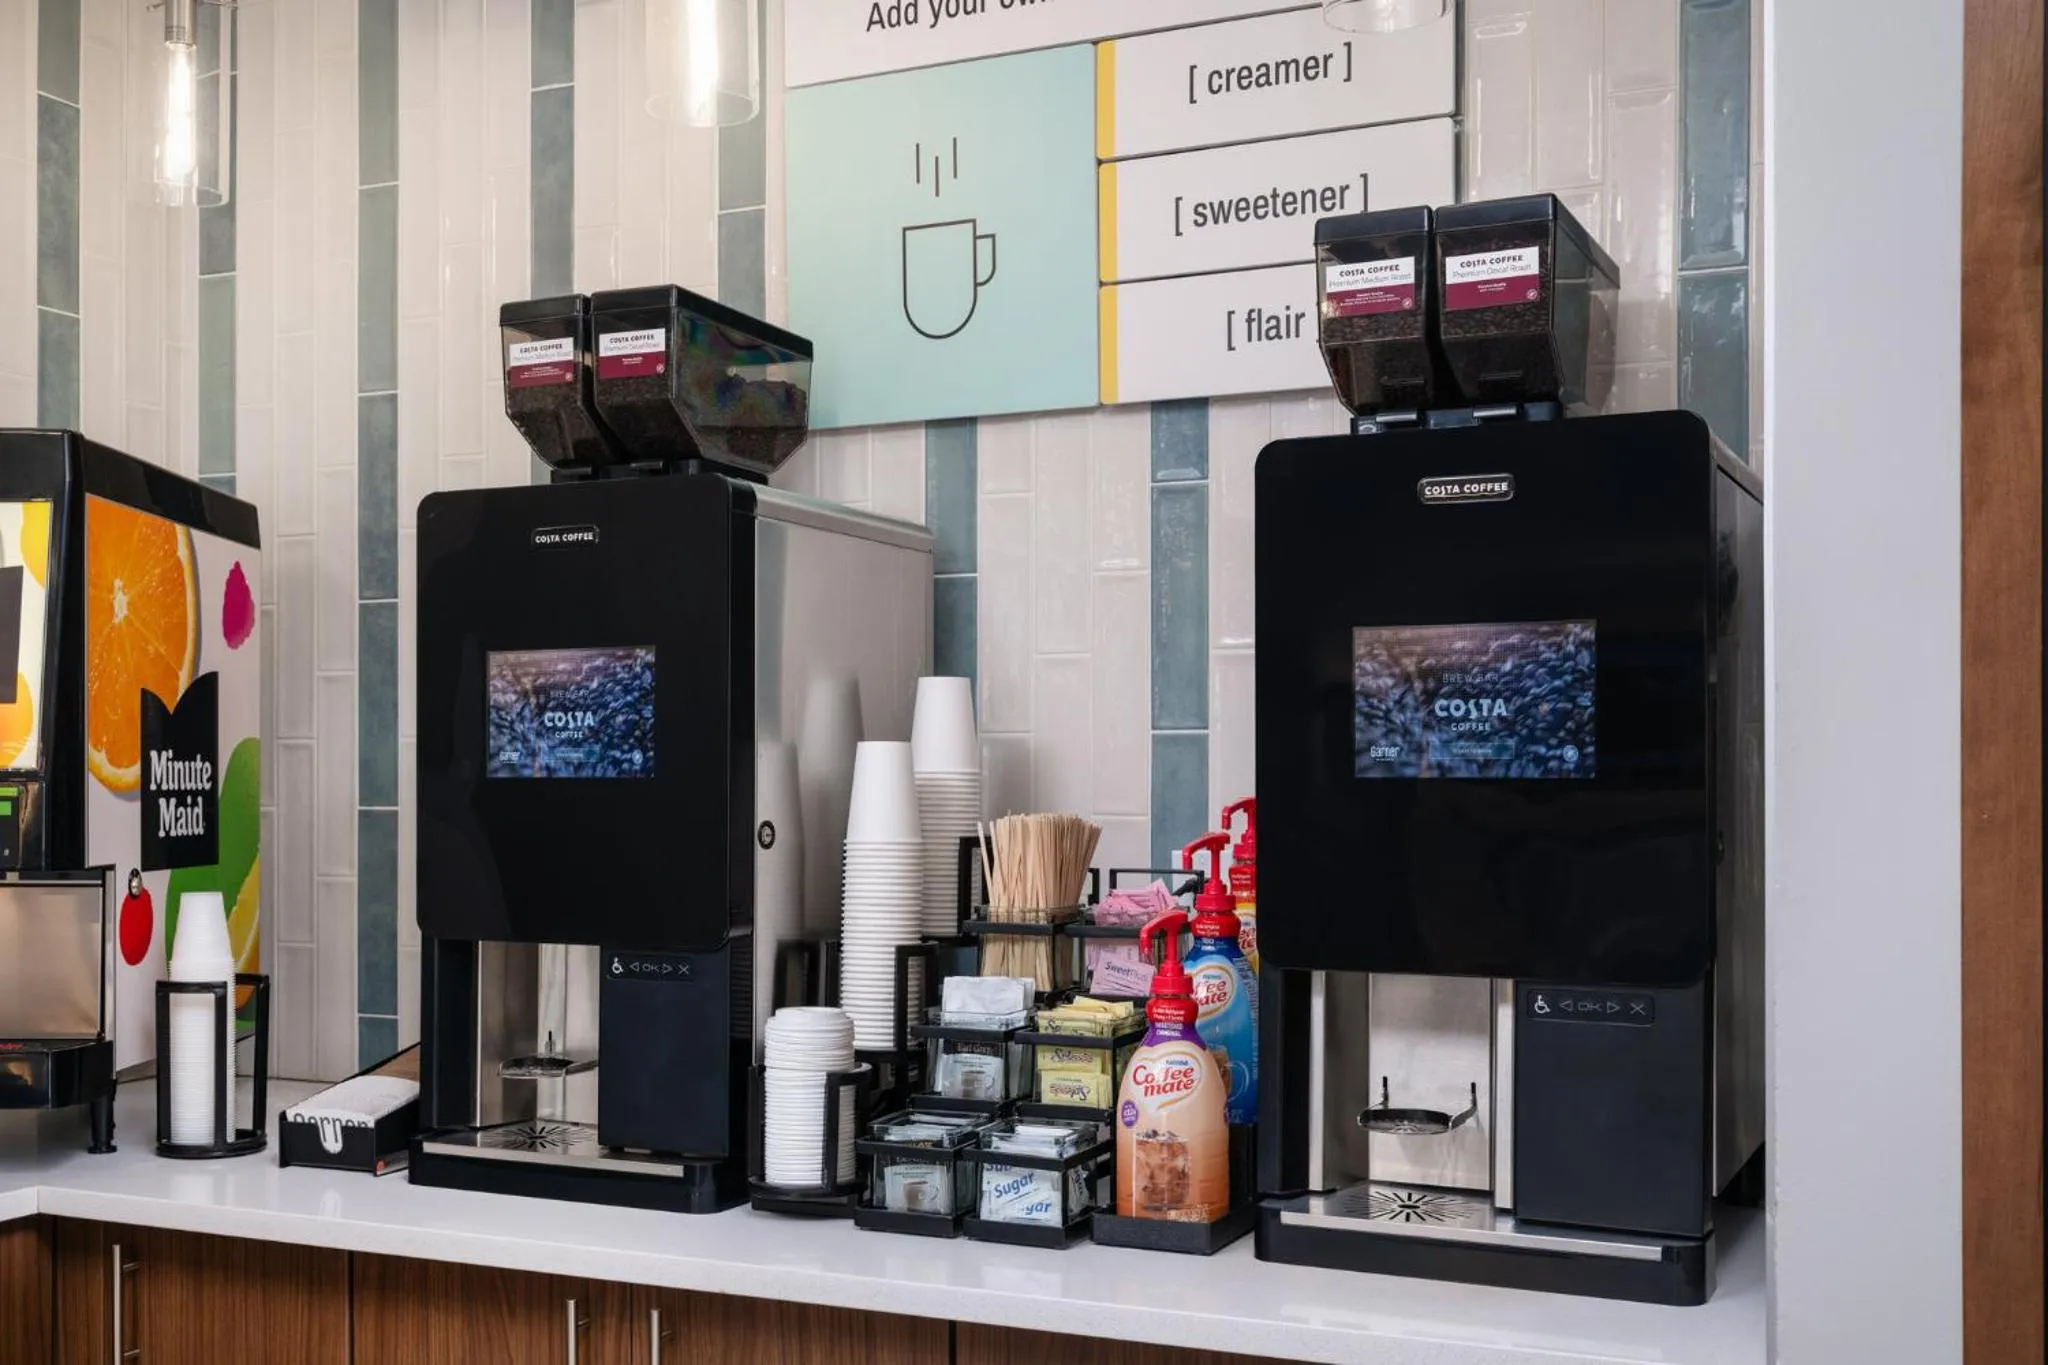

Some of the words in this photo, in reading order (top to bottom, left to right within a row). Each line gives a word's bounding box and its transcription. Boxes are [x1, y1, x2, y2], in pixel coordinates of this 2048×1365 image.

[866, 0, 918, 32] Add
[1207, 50, 1334, 96] creamer
[1192, 183, 1350, 228] sweetener
[1339, 268, 1366, 278] COSTA
[1367, 263, 1401, 274] COFFEE
[1460, 259, 1486, 269] COSTA
[1488, 254, 1523, 265] COFFEE
[1452, 268, 1486, 278] Premium
[1245, 307, 1307, 343] flair
[609, 336, 630, 344] COSTA
[630, 333, 655, 342] COFFEE
[519, 345, 539, 354] COSTA
[539, 342, 563, 352] COFFEE
[1424, 484, 1461, 496] COSTA
[1463, 482, 1509, 493] COFFEE
[534, 534, 561, 544] COSTA
[562, 531, 595, 542] COFFEE
[1434, 698, 1508, 719] COSTA
[544, 711, 595, 729] COSTA
[1450, 722, 1491, 732] COFFEE
[555, 731, 584, 739] COFFEE
[150, 749, 212, 791] Minute
[158, 795, 205, 838] Maid
[1132, 1064, 1195, 1085] Cofee
[1144, 1078, 1195, 1097] mate
[994, 1172, 1035, 1198] Sugar
